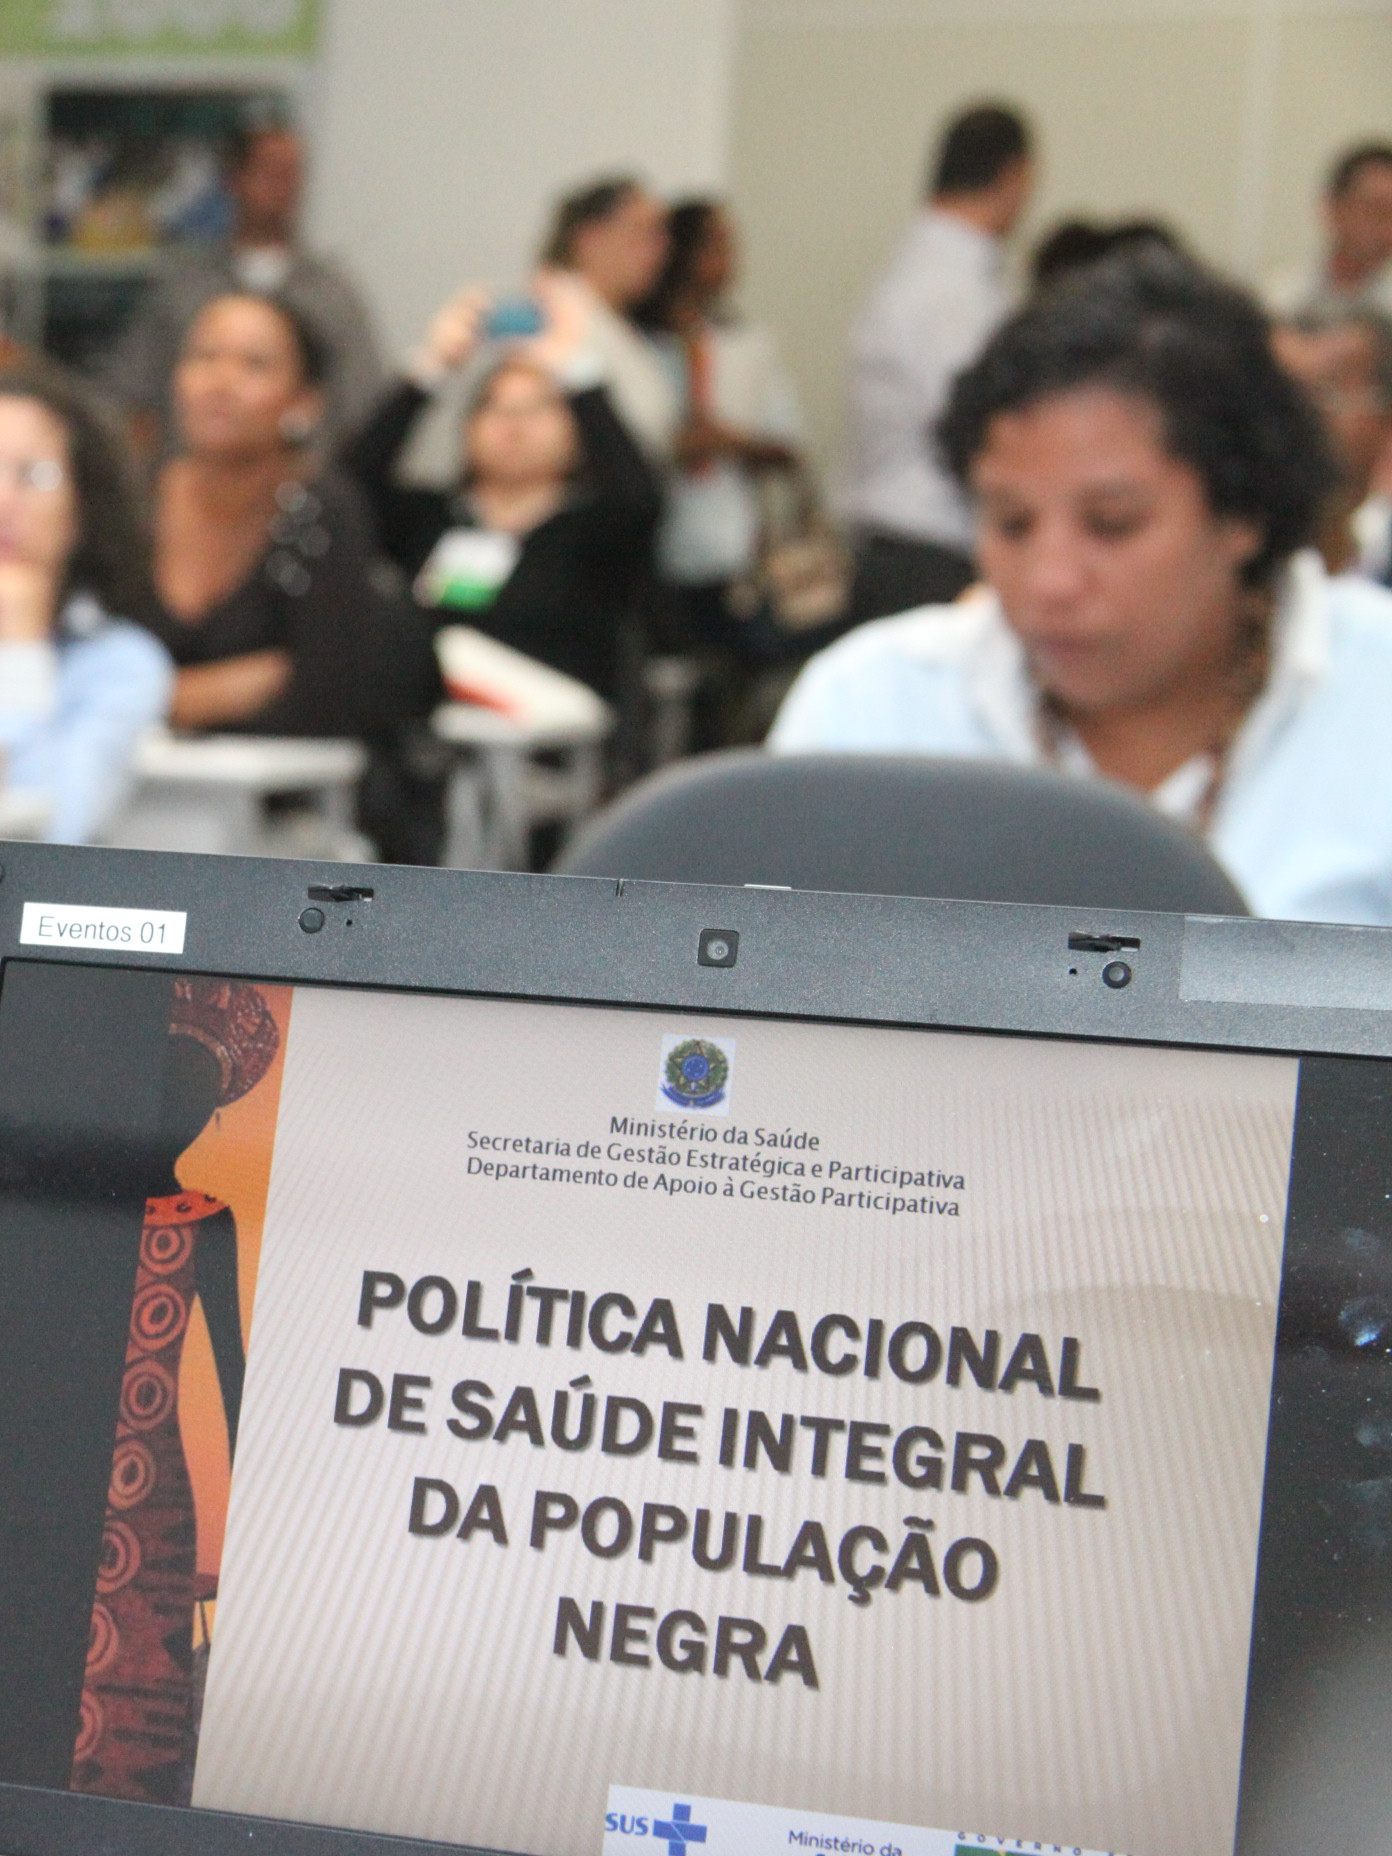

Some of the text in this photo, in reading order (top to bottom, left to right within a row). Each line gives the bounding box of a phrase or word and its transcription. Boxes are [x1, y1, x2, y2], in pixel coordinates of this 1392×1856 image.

[38, 916, 166, 944] Eventos 01
[467, 1131, 965, 1190] Secretaria de Gestão Estratégica e Participativa
[610, 1116, 820, 1151] Ministério da Saúde
[467, 1157, 960, 1216] Departamento de Apoio à Gestão Participativa
[358, 1267, 1101, 1401] POLÍTICA NACIONAL
[334, 1368, 1107, 1508] DE SAÚDE INTEGRAL
[408, 1477, 999, 1606] DA POPULAÇÃO
[553, 1596, 820, 1690] NEGRA
[604, 1812, 649, 1836] SUS
[788, 1830, 902, 1856] Ministério da
[958, 1831, 1082, 1856] GOVERNO
